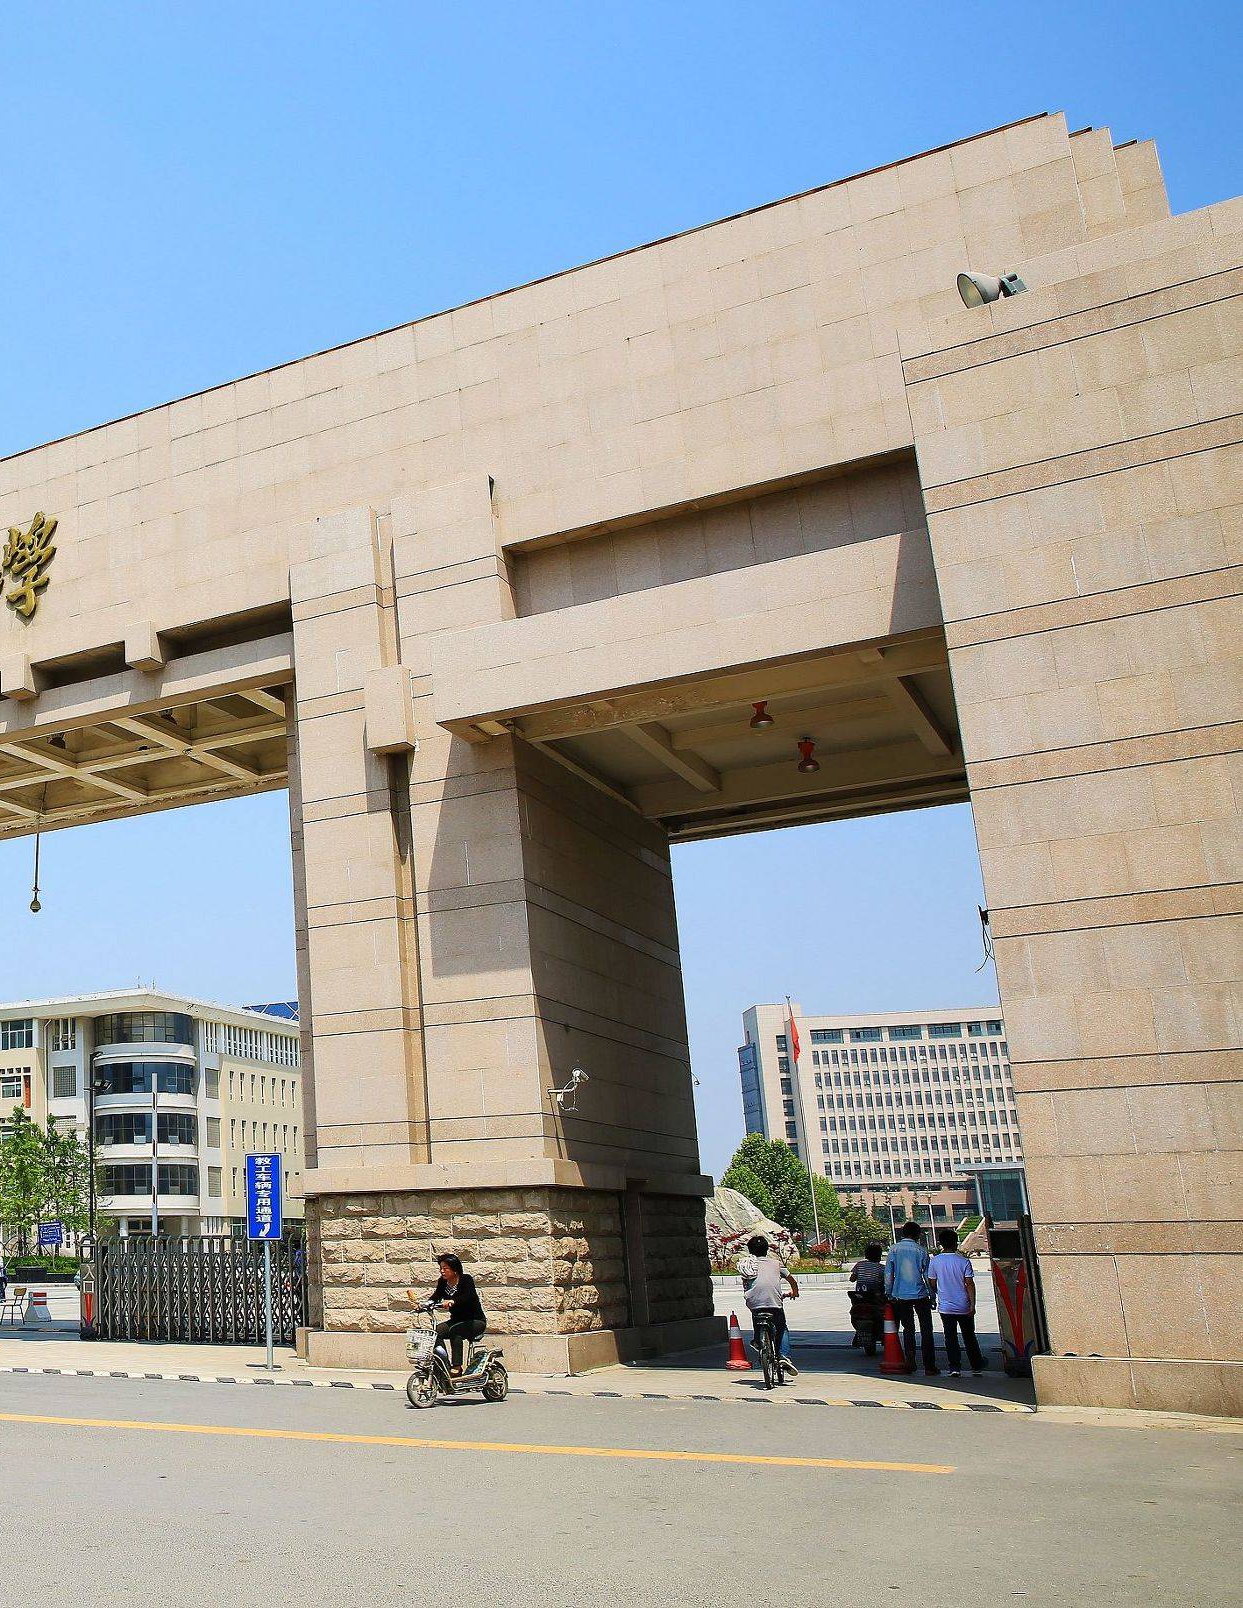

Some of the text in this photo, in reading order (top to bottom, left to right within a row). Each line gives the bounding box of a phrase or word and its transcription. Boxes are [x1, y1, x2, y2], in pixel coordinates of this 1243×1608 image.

[255, 1157, 272, 1222] 教工车辆专用通道
